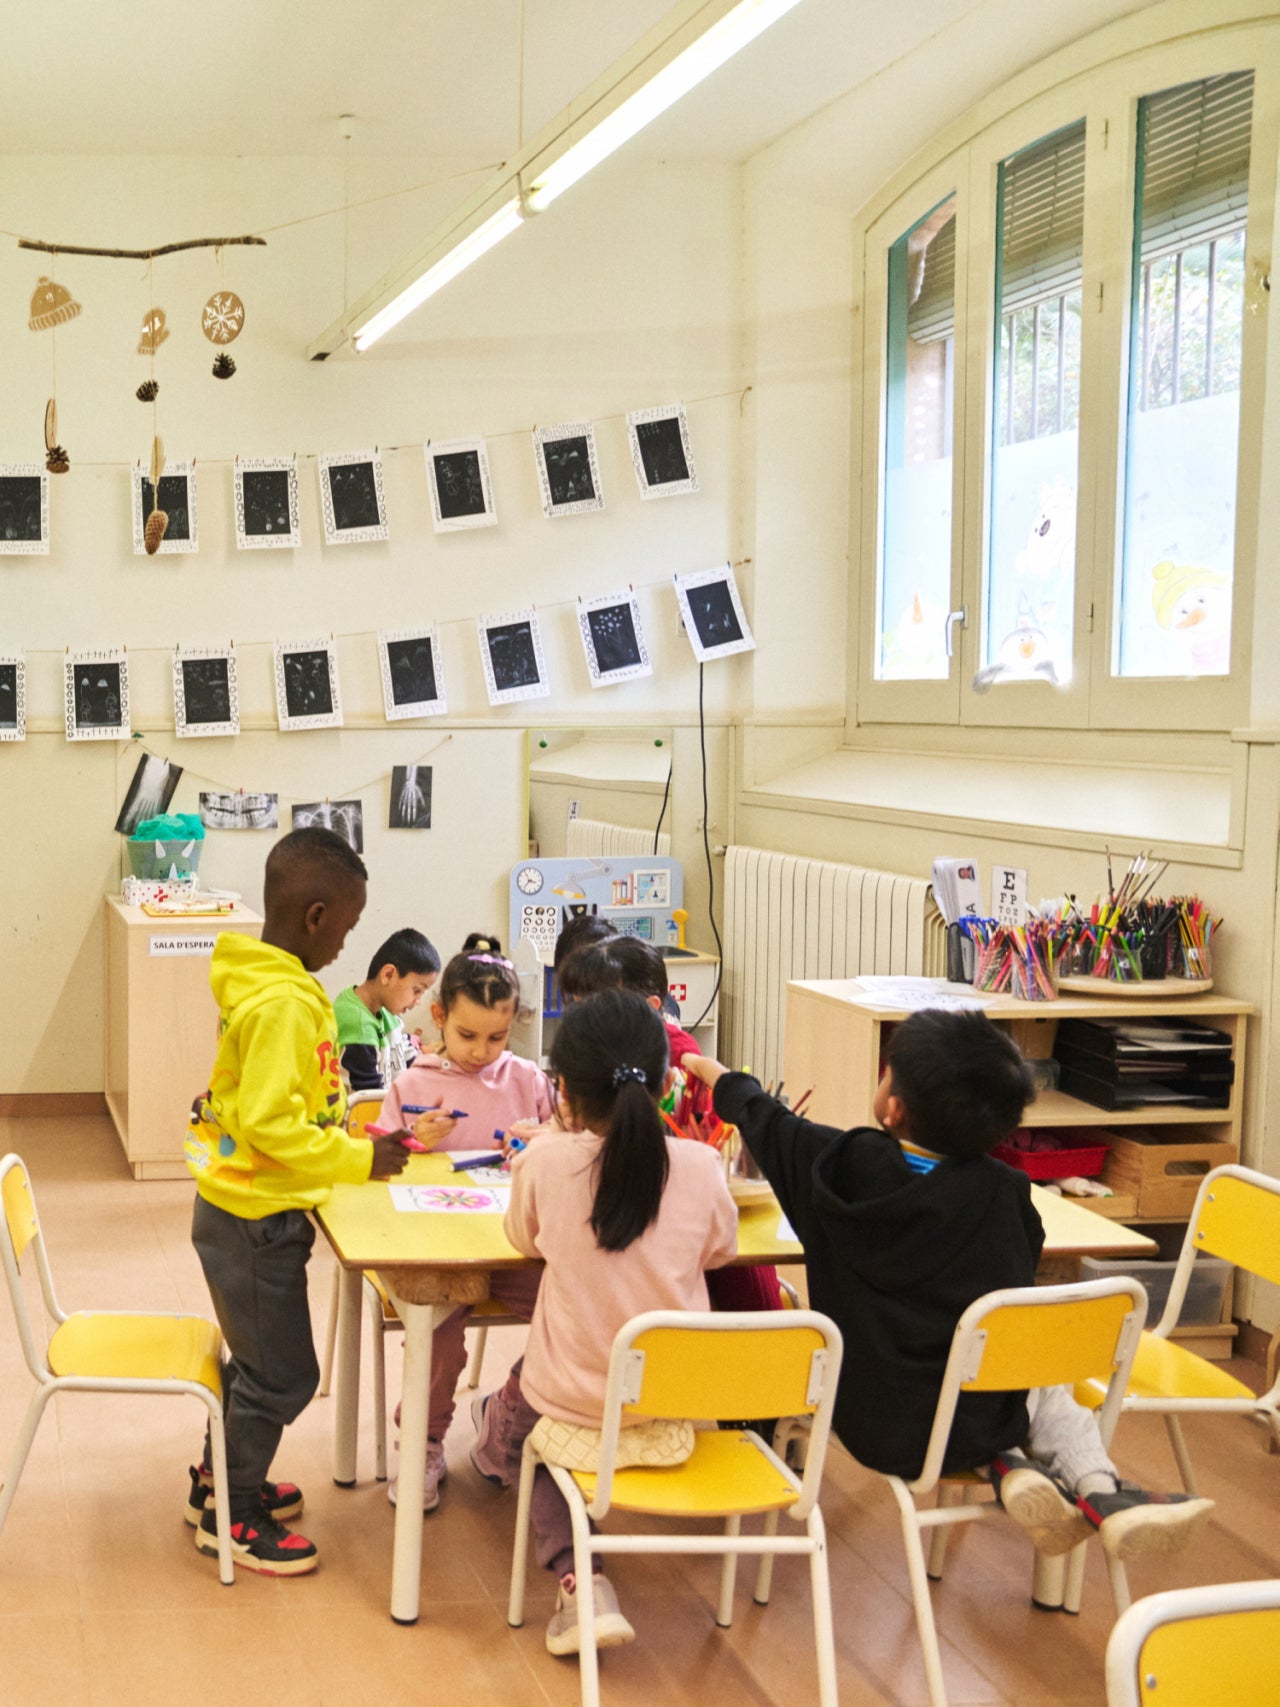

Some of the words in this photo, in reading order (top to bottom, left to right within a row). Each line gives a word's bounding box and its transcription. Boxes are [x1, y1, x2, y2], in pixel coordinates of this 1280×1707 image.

[1003, 871, 1016, 890] E
[1000, 892, 1007, 903] F
[1010, 894, 1017, 905] P
[154, 941, 175, 949] SALA
[176, 941, 214, 949] D'ESPERA
